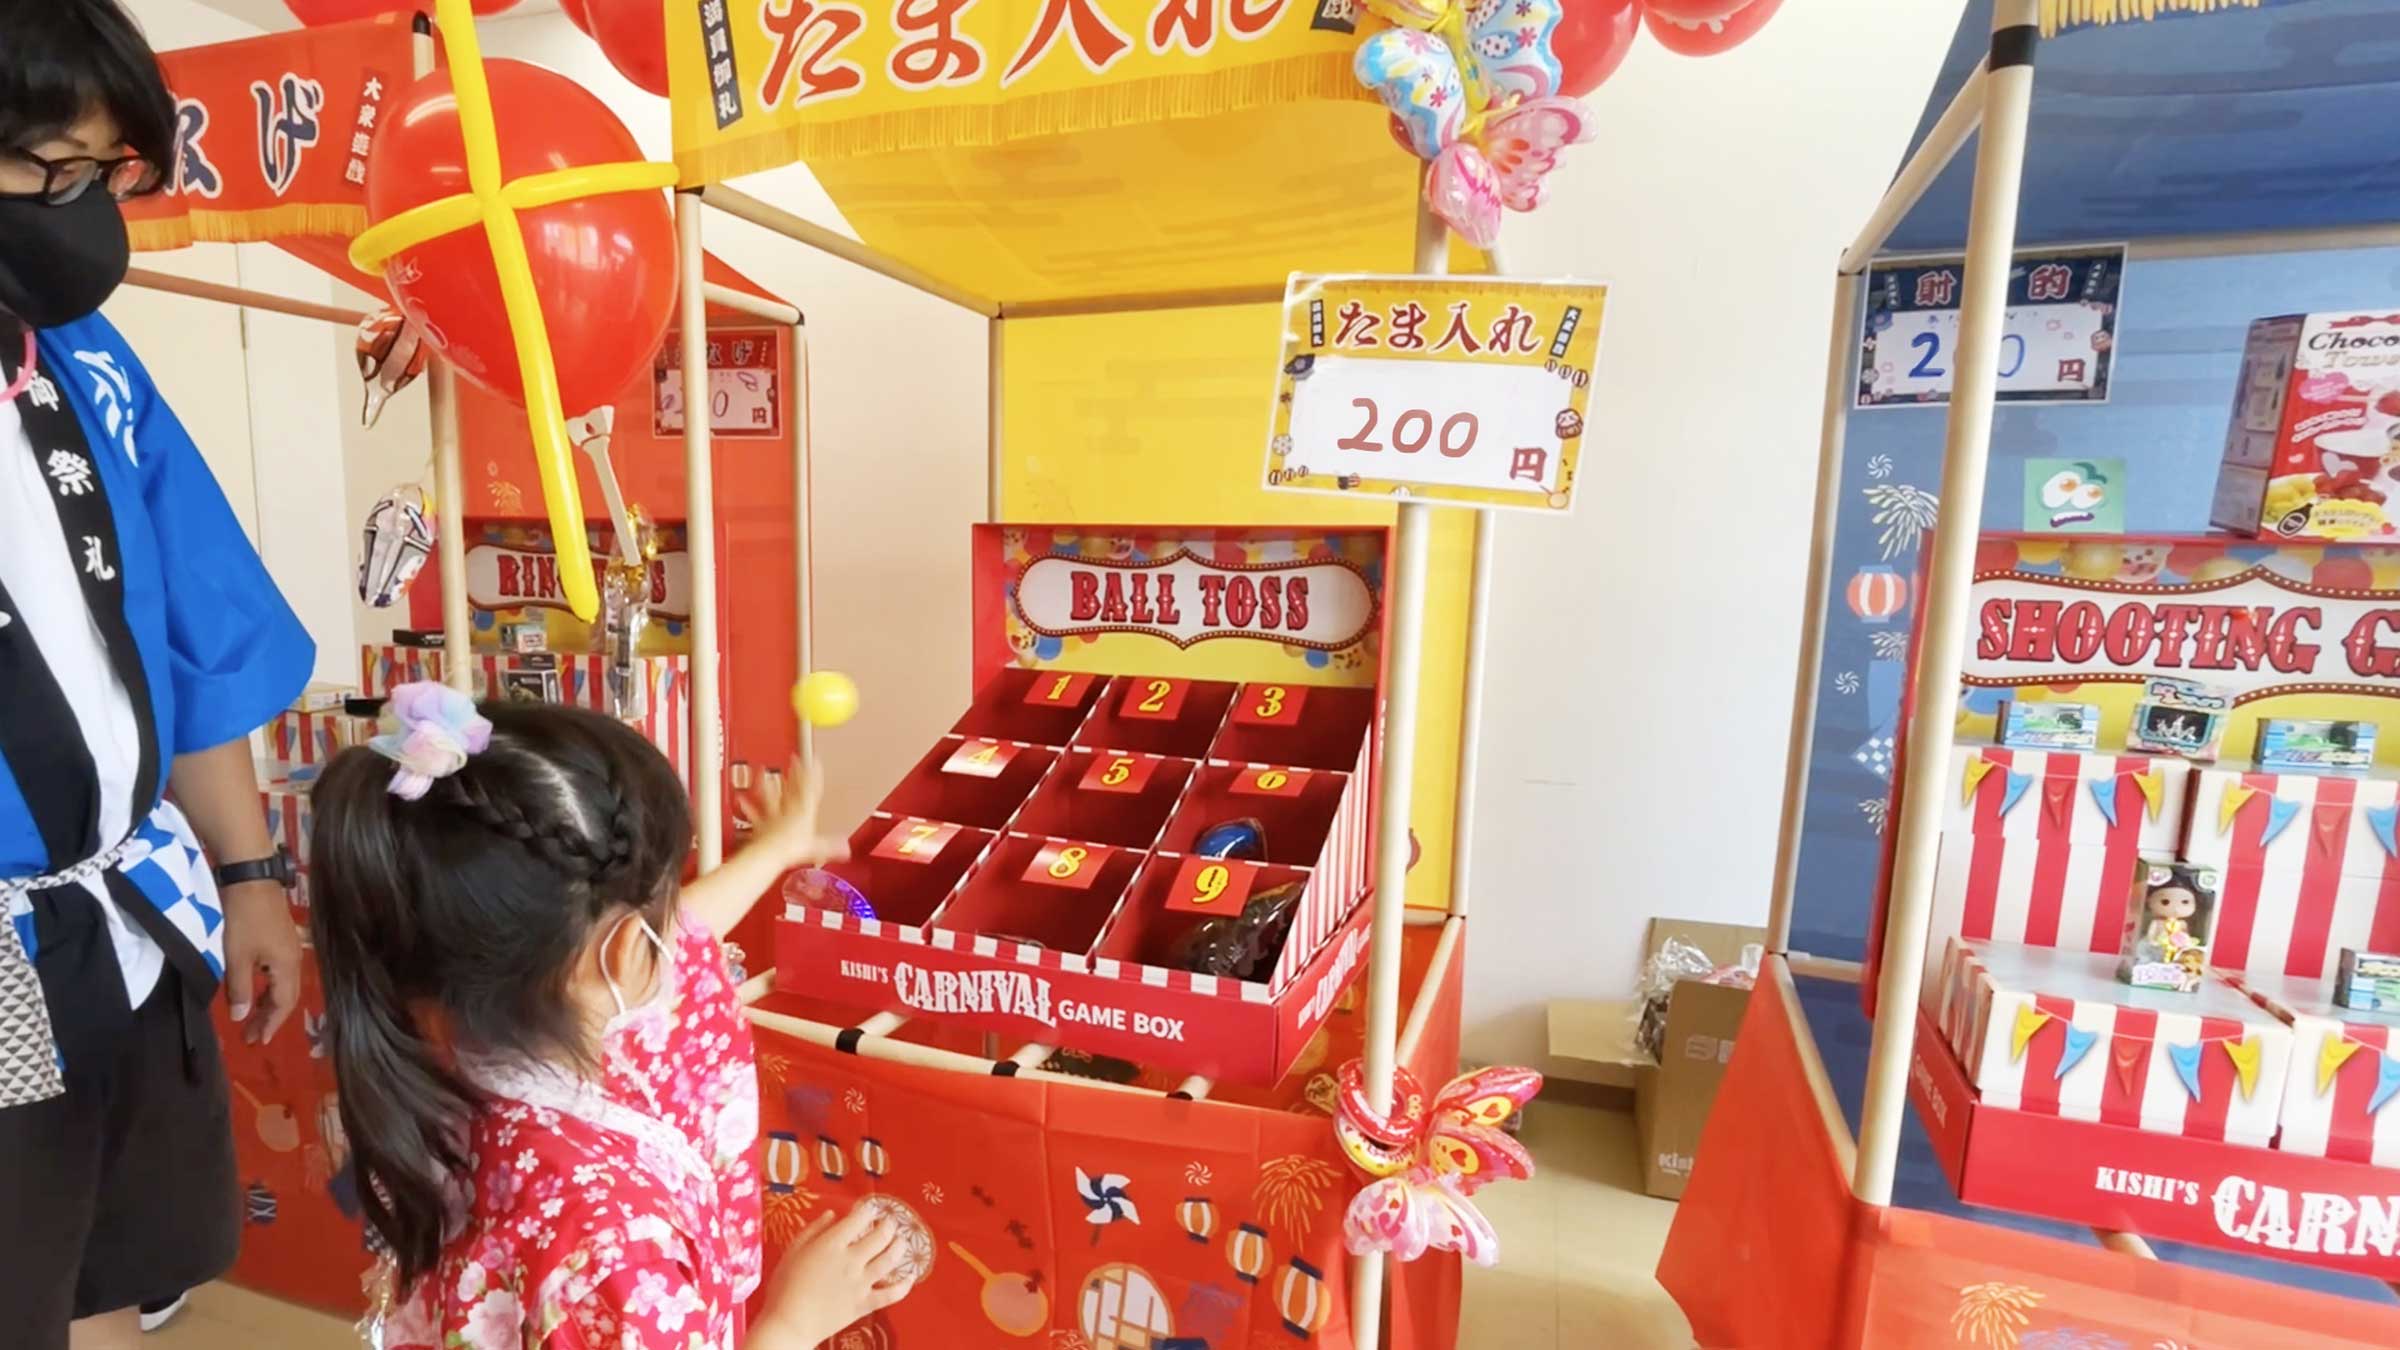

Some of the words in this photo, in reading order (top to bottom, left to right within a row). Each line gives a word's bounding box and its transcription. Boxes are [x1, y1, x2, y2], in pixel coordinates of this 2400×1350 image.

[1333, 300, 1543, 354] たま入れ
[2056, 358, 2086, 383] 円
[1337, 397, 1479, 458] 200
[1509, 447, 1548, 482] 円
[497, 554, 567, 598] RIN
[1069, 571, 1180, 625] BALL
[1199, 574, 1310, 631] TOSS
[1976, 598, 2322, 674] SHOOTING
[1047, 674, 1073, 701] 1
[1138, 680, 1173, 713] 2
[1256, 687, 1283, 717] 3
[967, 746, 1000, 765] 4
[1101, 758, 1135, 785] 5
[897, 826, 933, 855] 7
[1047, 847, 1088, 878] 8
[1191, 865, 1230, 904] 9
[840, 960, 889, 983] KISHI'S
[894, 961, 1057, 1028] CARNIVAL
[1058, 999, 1126, 1031] GAME
[1133, 1013, 1184, 1042] BOX
[2095, 1167, 2200, 1205] KISHI'S
